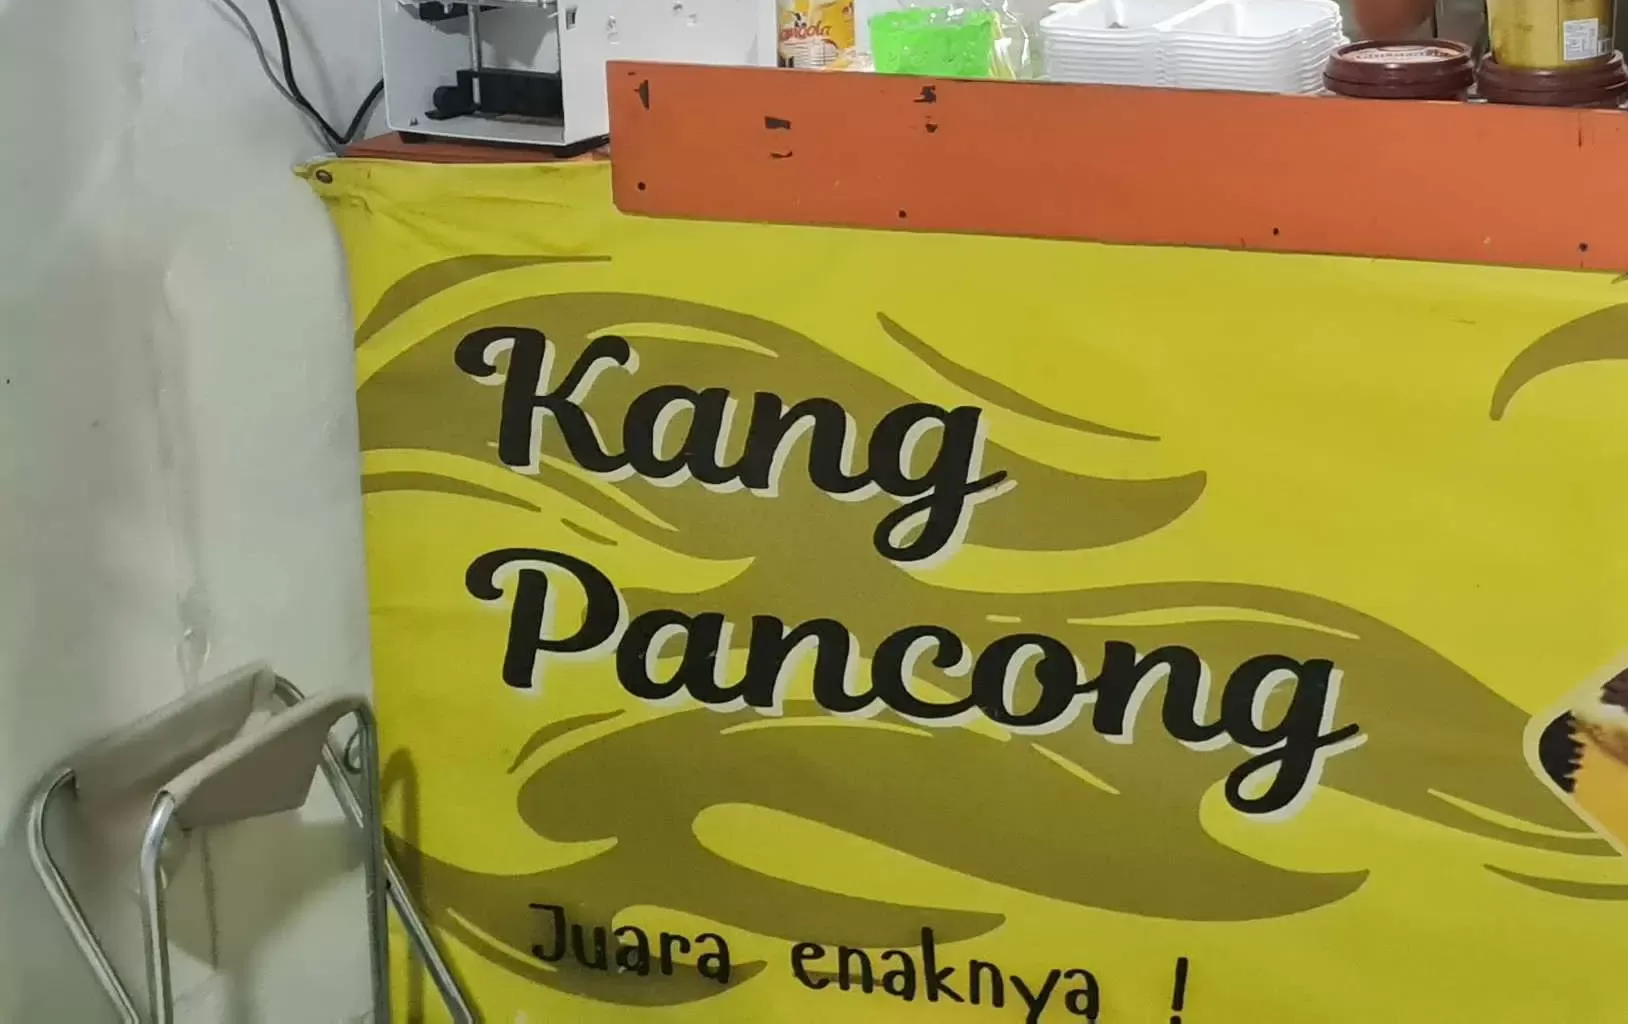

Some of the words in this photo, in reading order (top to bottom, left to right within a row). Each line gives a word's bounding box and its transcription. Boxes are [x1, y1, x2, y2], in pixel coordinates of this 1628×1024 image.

[454, 326, 1014, 566] Kang
[464, 547, 1365, 818] Pancong
[528, 902, 733, 985] Juara
[790, 926, 1102, 1024] enaknya
